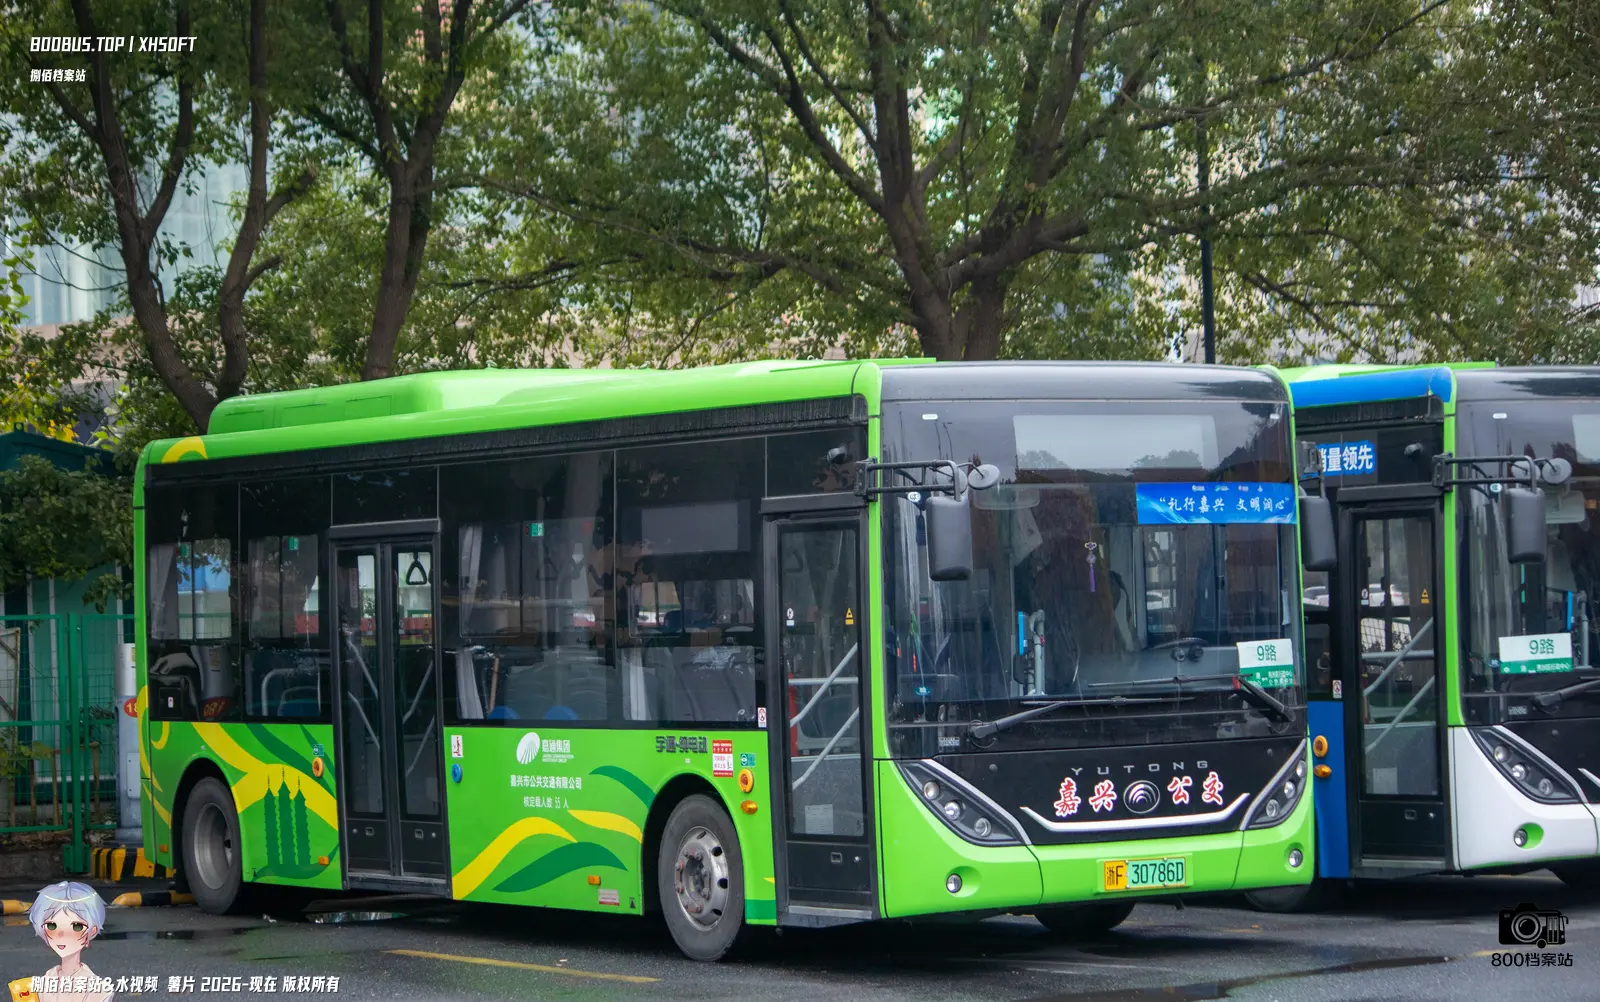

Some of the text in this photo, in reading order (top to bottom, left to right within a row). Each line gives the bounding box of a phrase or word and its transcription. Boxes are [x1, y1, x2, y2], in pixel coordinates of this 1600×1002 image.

[1256, 644, 1277, 661] 9路
[1526, 638, 1555, 655] 9路
[1071, 760, 1209, 776] YUTONG
[1131, 861, 1184, 884] 30786D
